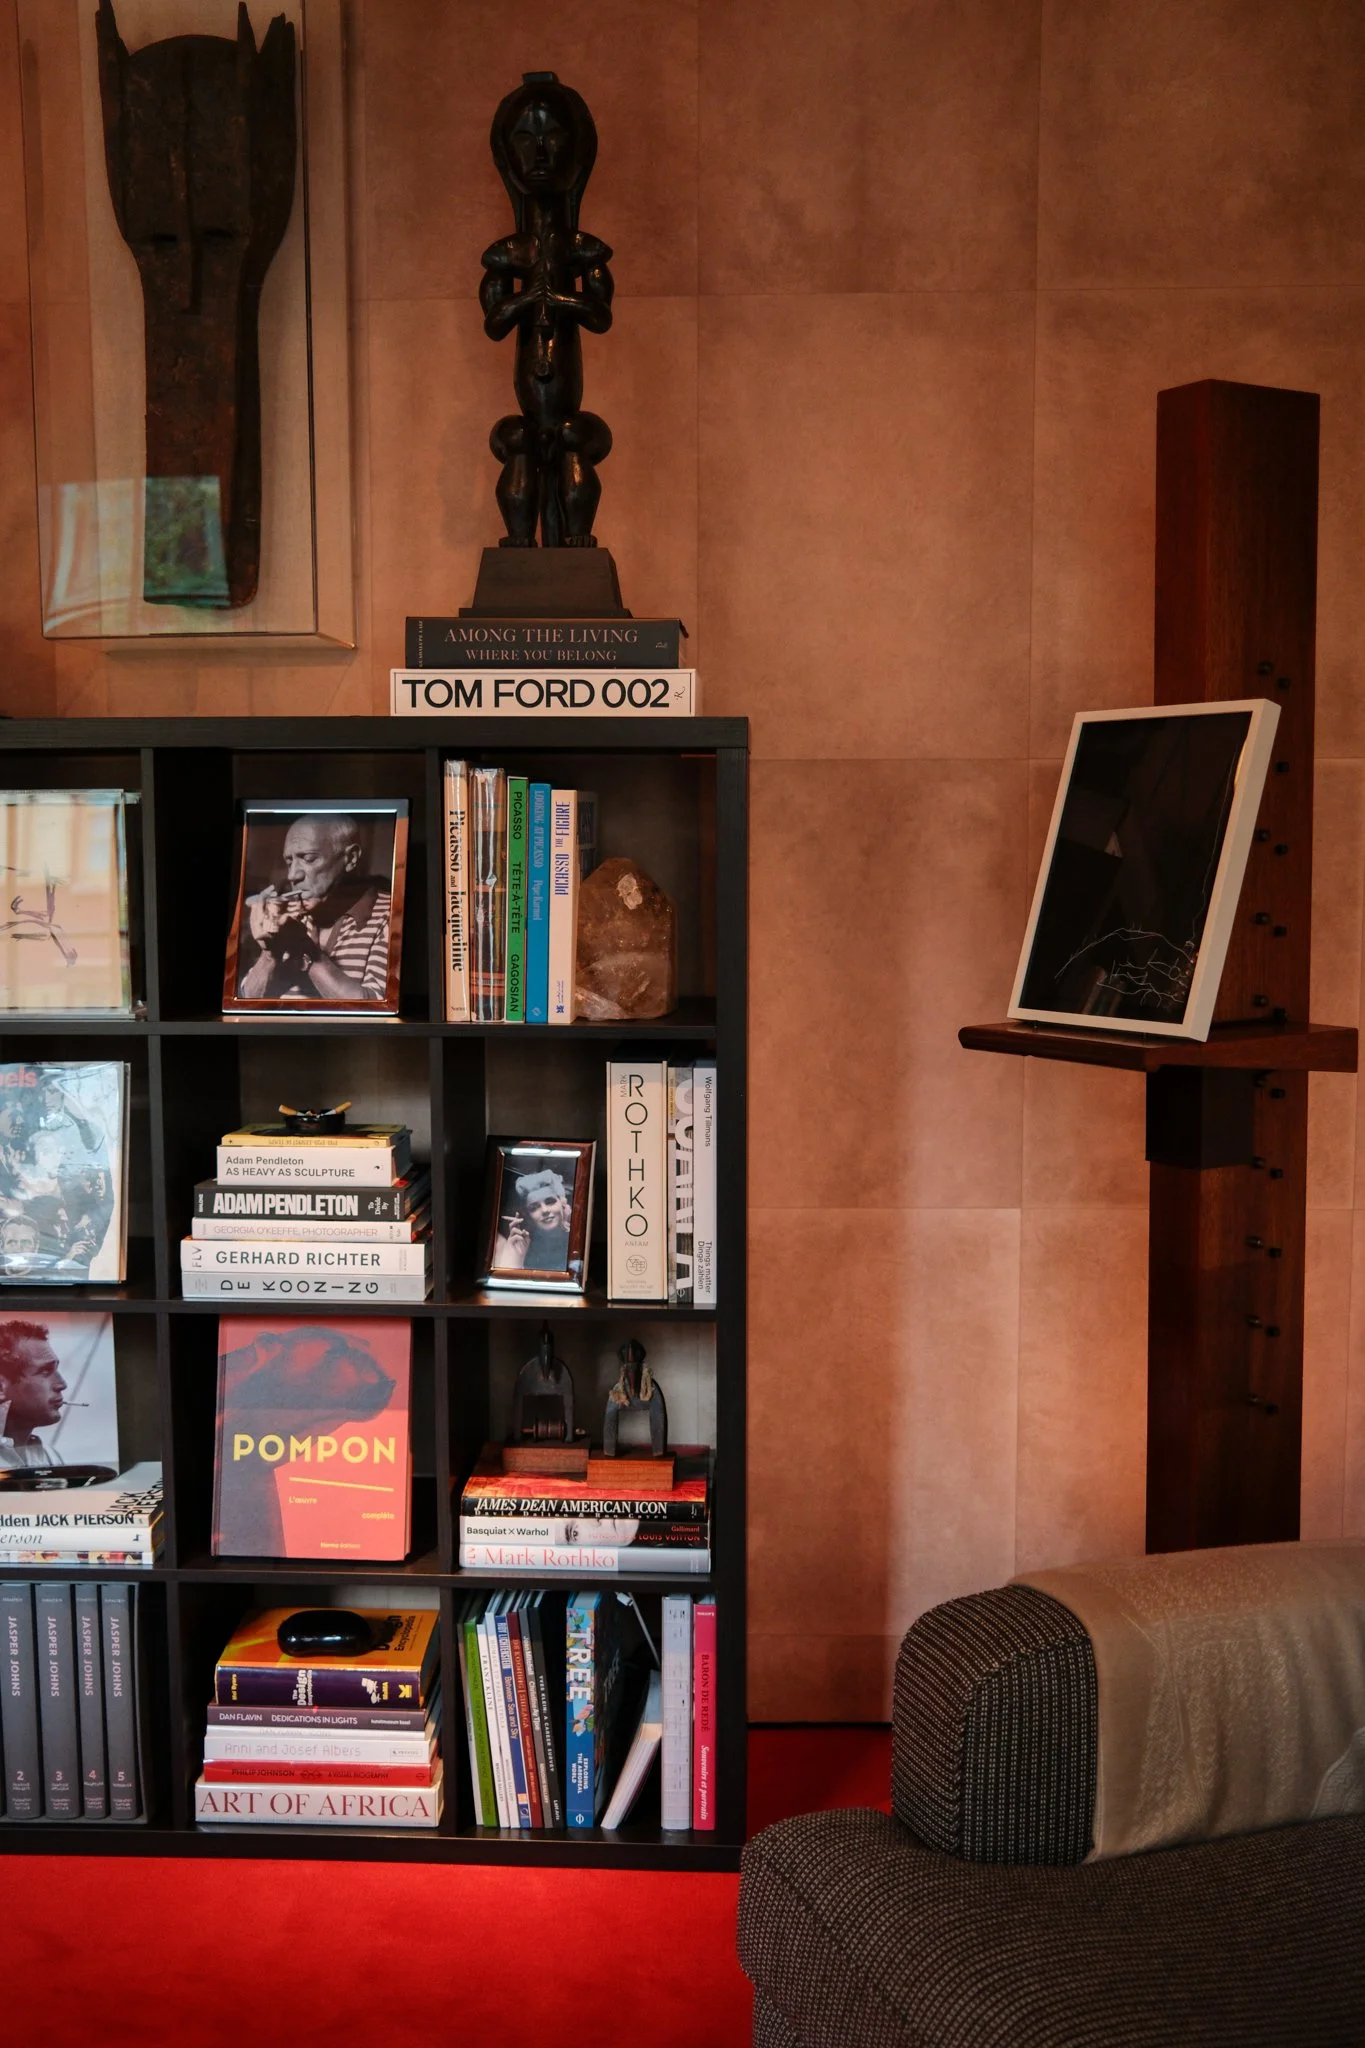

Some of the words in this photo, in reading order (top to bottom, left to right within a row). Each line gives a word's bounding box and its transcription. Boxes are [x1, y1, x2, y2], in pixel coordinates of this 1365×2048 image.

[445, 628, 516, 642] AMONG
[523, 628, 564, 643] THE
[569, 629, 638, 644] LIVING
[466, 649, 520, 660] WHERE
[524, 649, 553, 661] YOU
[557, 650, 617, 661] BELONG
[402, 679, 483, 708] TOM
[494, 679, 595, 708] FORD
[601, 679, 669, 708] 002
[513, 792, 523, 840] PICASSO
[534, 790, 545, 824] LOOKING
[555, 801, 570, 836] FIGURE
[449, 810, 466, 872] Picasso
[534, 825, 544, 834] AT
[533, 834, 544, 868] PICASSO
[555, 854, 569, 895] PICASSO
[511, 863, 523, 934] TÊTE-À-TÊTE
[531, 880, 543, 895] Pepe
[532, 896, 543, 920] Karmel
[447, 891, 467, 972] Jacqueline
[510, 954, 520, 1012] GAGOSIAN
[704, 1076, 712, 1113] Wolfgang
[226, 1156, 253, 1165] Adam
[256, 1156, 304, 1165] Pendleton
[625, 1074, 648, 1237] ROTHKO
[226, 1168, 240, 1176] AS
[242, 1168, 276, 1176] HEAVY
[278, 1168, 292, 1176] AS
[294, 1168, 355, 1177] SCULPTURE
[213, 1193, 263, 1215] ADAM
[264, 1194, 359, 1216] PENDLETON
[382, 1202, 389, 1210] By
[214, 1226, 251, 1236] GEORGIA
[302, 1227, 378, 1237] PHOTOGRAPHER
[216, 1251, 300, 1265] GERHARD
[306, 1253, 381, 1266] RICHTER
[697, 1241, 705, 1262] Dinge
[704, 1240, 712, 1267] Things
[220, 1280, 250, 1290] DE
[233, 1434, 396, 1464] POMPON
[474, 1498, 517, 1511] JAMES
[520, 1499, 558, 1511] DEAN
[560, 1500, 631, 1513] AMERICAN
[634, 1501, 668, 1514] ICON
[35, 1514, 69, 1527] JACK
[74, 1513, 135, 1526] PIERSON
[466, 1526, 507, 1536] Basquiat
[516, 1528, 549, 1536] Warhol
[485, 1547, 535, 1566] Mark
[544, 1548, 615, 1568] Rothko
[8, 1616, 19, 1656] JASPER
[48, 1616, 58, 1656] JASPER
[82, 1616, 92, 1655] JASPER
[110, 1616, 120, 1656] JASPER
[497, 1622, 508, 1633] ROY
[498, 1634, 511, 1669] LICHTENSTEIN
[524, 1651, 534, 1675] Mitchell
[482, 1655, 490, 1681] FRANZ
[569, 1627, 592, 1701] TREE
[700, 1654, 710, 1688] BARON
[10, 1660, 20, 1697] JOHNS
[50, 1660, 60, 1697] JOHNS
[84, 1659, 93, 1696] JOHNS
[112, 1660, 122, 1697] JOHNS
[296, 1669, 307, 1706] Design
[504, 1676, 514, 1702] Between
[538, 1675, 546, 1691] YVES
[528, 1680, 538, 1708] Christine
[700, 1690, 709, 1703] DE
[219, 1712, 236, 1720] DAN
[237, 1713, 263, 1721] FLAVIN
[271, 1714, 322, 1723] DEDICATIONS
[322, 1716, 330, 1724] IN
[331, 1716, 358, 1725] LIGHTS
[497, 1705, 505, 1728] STELLA
[507, 1703, 516, 1715] Sea
[532, 1709, 540, 1718] Ay
[700, 1706, 711, 1732] REDÉ
[509, 1716, 517, 1728] and
[510, 1728, 519, 1739] Sky
[533, 1718, 541, 1731] Tjoe
[224, 1743, 251, 1753] Anni
[256, 1744, 277, 1755] and
[282, 1744, 318, 1756] Josef
[323, 1744, 361, 1757] Albers
[89, 1770, 97, 1779] 4
[258, 1769, 295, 1777] JOHNSON
[700, 1745, 710, 1780] Souvenirs
[16, 1771, 24, 1781] 2
[55, 1771, 63, 1781] 3
[117, 1771, 125, 1781] 5
[200, 1792, 263, 1814] ART
[270, 1793, 310, 1815] OF
[317, 1794, 430, 1818] AFRICA
[698, 1789, 709, 1821] portraits
